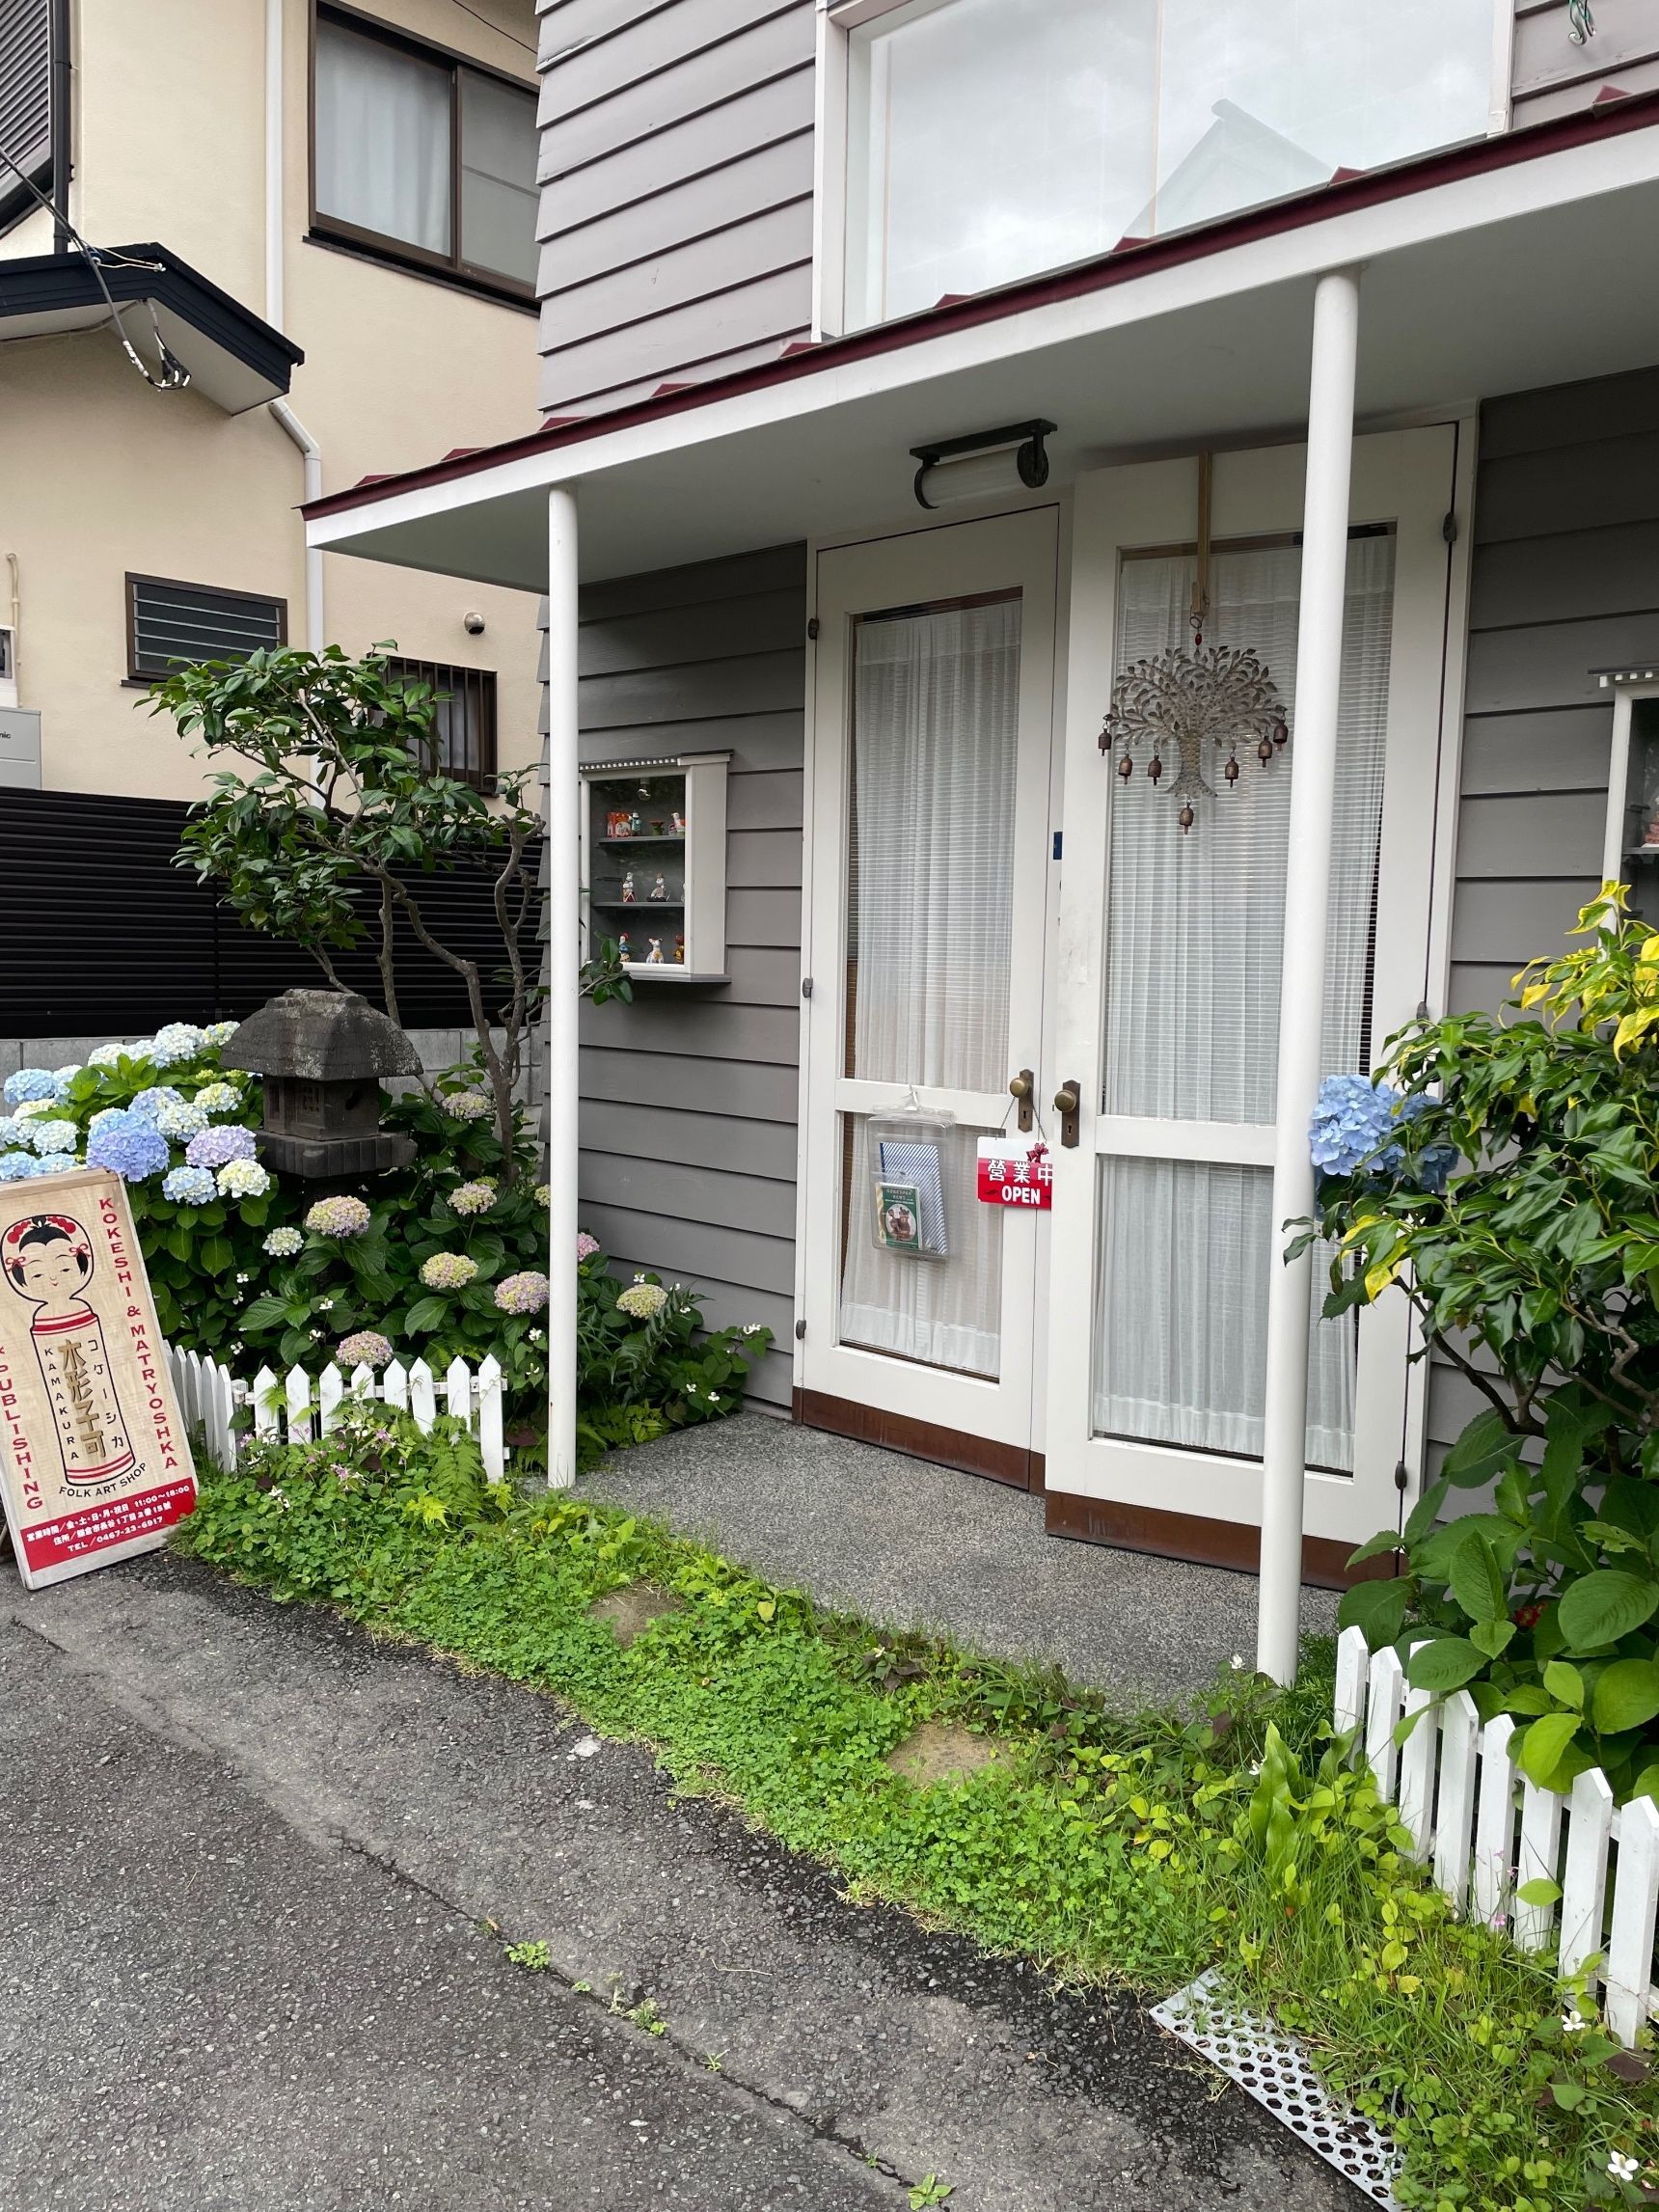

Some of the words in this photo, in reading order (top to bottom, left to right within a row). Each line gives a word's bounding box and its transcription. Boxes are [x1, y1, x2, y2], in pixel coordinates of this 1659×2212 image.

[99, 1197, 132, 1297] KOKESHI
[1001, 1185, 1041, 1205] OPEN
[126, 1305, 141, 1318] &
[44, 1348, 79, 1460] KAMAKURA
[58, 1339, 106, 1458] 木形子可
[88, 1339, 124, 1449] コケーシカ
[131, 1324, 178, 1469] MATRYOSHKA
[59, 1486, 92, 1497] FOLK
[95, 1483, 117, 1496] ART
[120, 1462, 147, 1488] SHOP
